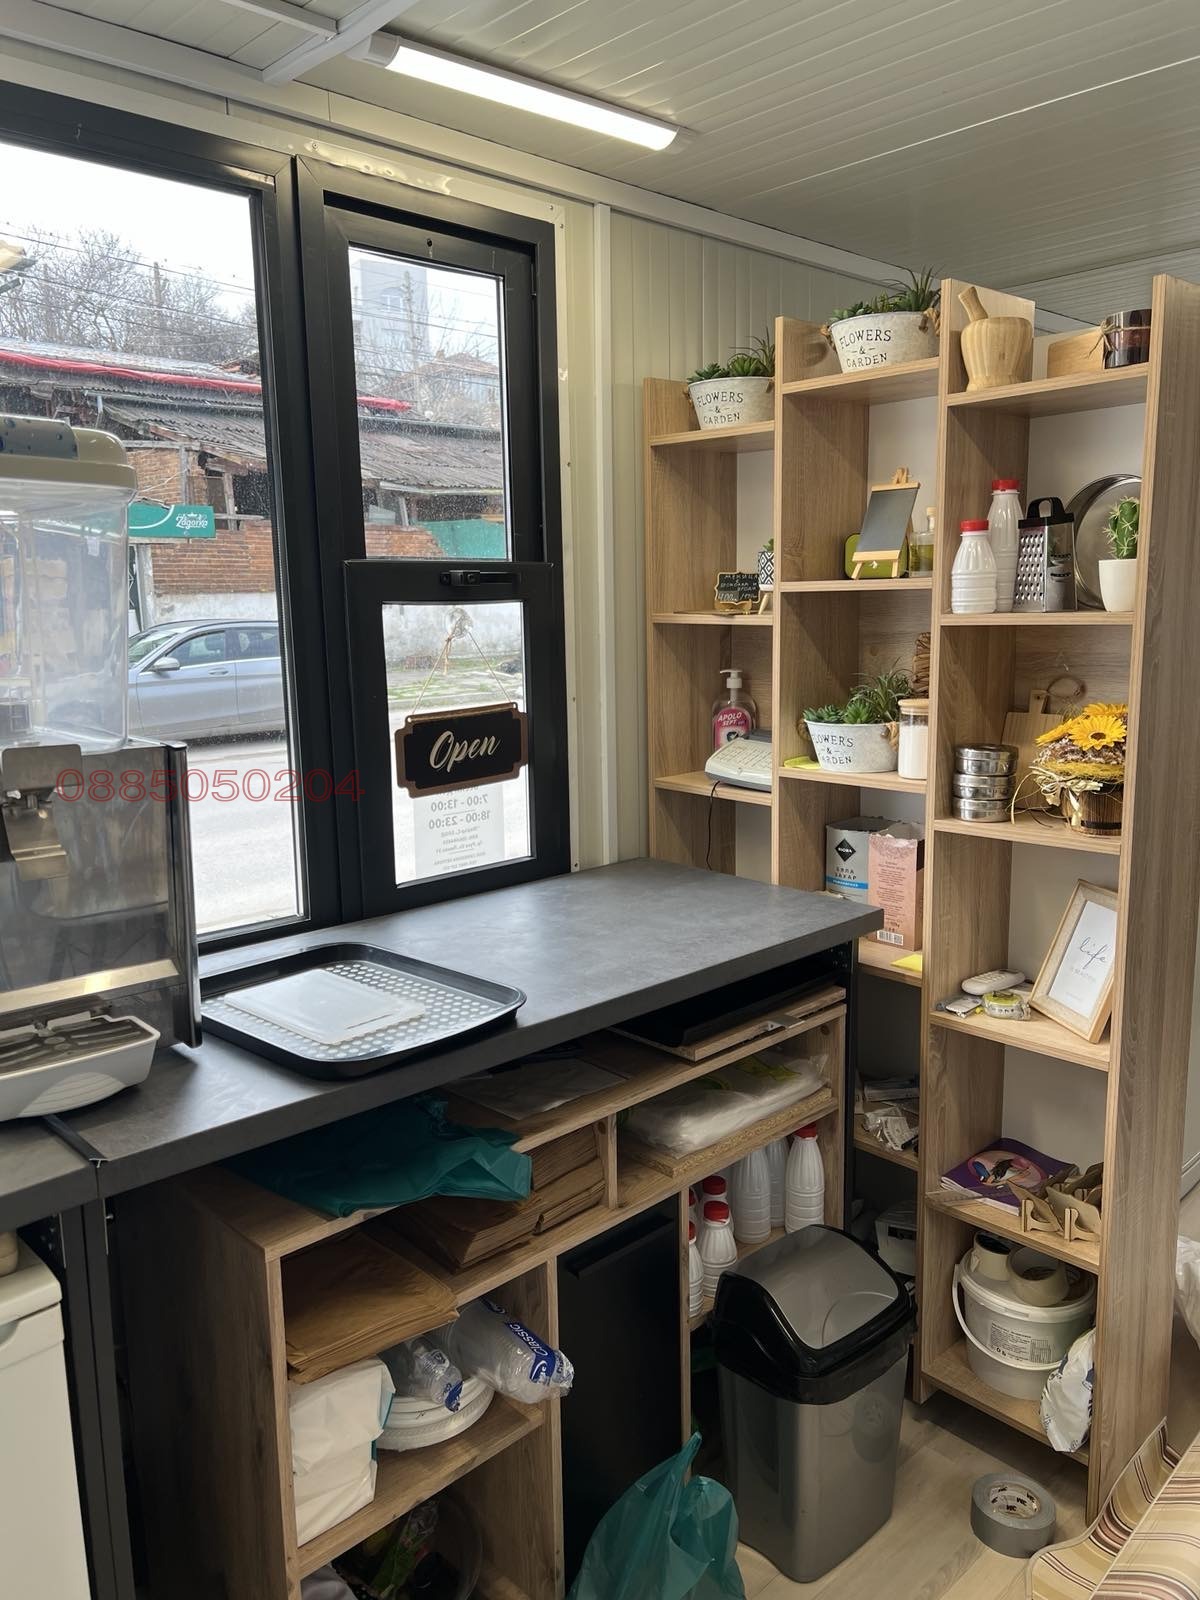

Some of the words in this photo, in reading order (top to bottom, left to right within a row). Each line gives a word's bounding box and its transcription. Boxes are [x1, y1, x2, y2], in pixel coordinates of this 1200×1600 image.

[839, 329, 892, 349] FLOWERS
[859, 345, 866, 355] &
[846, 352, 888, 368] GARDEN
[696, 391, 744, 408] FLOWERS
[714, 405, 721, 414] &
[703, 412, 741, 425] GARDEN
[717, 711, 743, 722] APOLO
[722, 719, 738, 727] SEPT
[429, 730, 502, 773] Open
[509, 1322, 549, 1357] Classic
